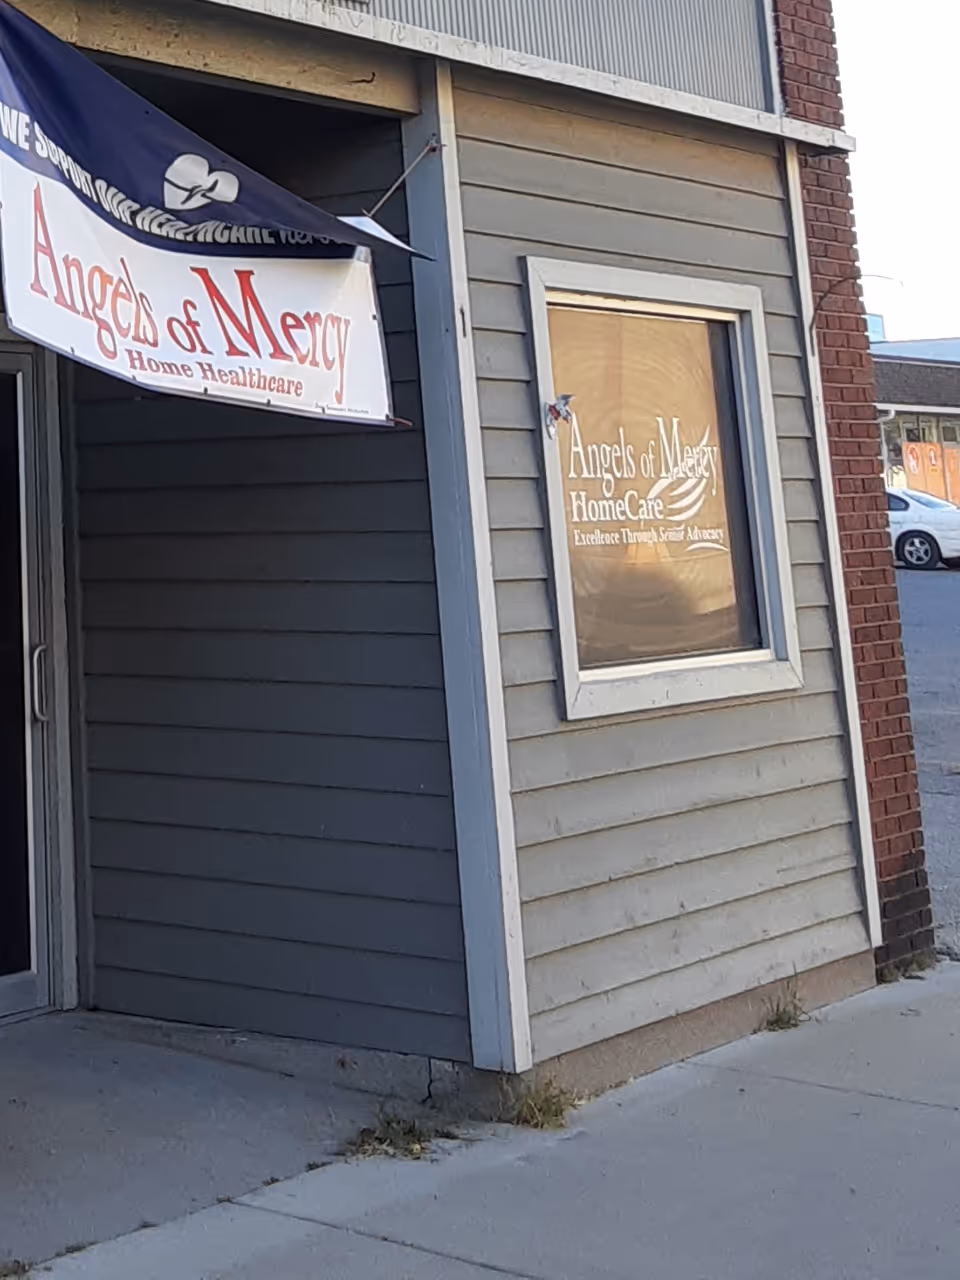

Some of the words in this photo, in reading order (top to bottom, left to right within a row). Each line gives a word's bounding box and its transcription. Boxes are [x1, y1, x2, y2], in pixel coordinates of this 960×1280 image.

[33, 120, 98, 204] SUPPORT
[95, 178, 141, 227] OUR
[30, 178, 159, 360] Angels
[167, 298, 215, 356] of
[190, 266, 352, 405] Mercy
[124, 348, 194, 379] Home
[195, 361, 304, 398] Healthcare
[568, 411, 636, 498] Angels
[640, 440, 655, 478] of
[656, 416, 719, 497] Mercy
[570, 490, 665, 523] HomeCare
[573, 528, 620, 546] Excellence
[621, 527, 658, 547] Through
[686, 525, 724, 543] Advocacy
